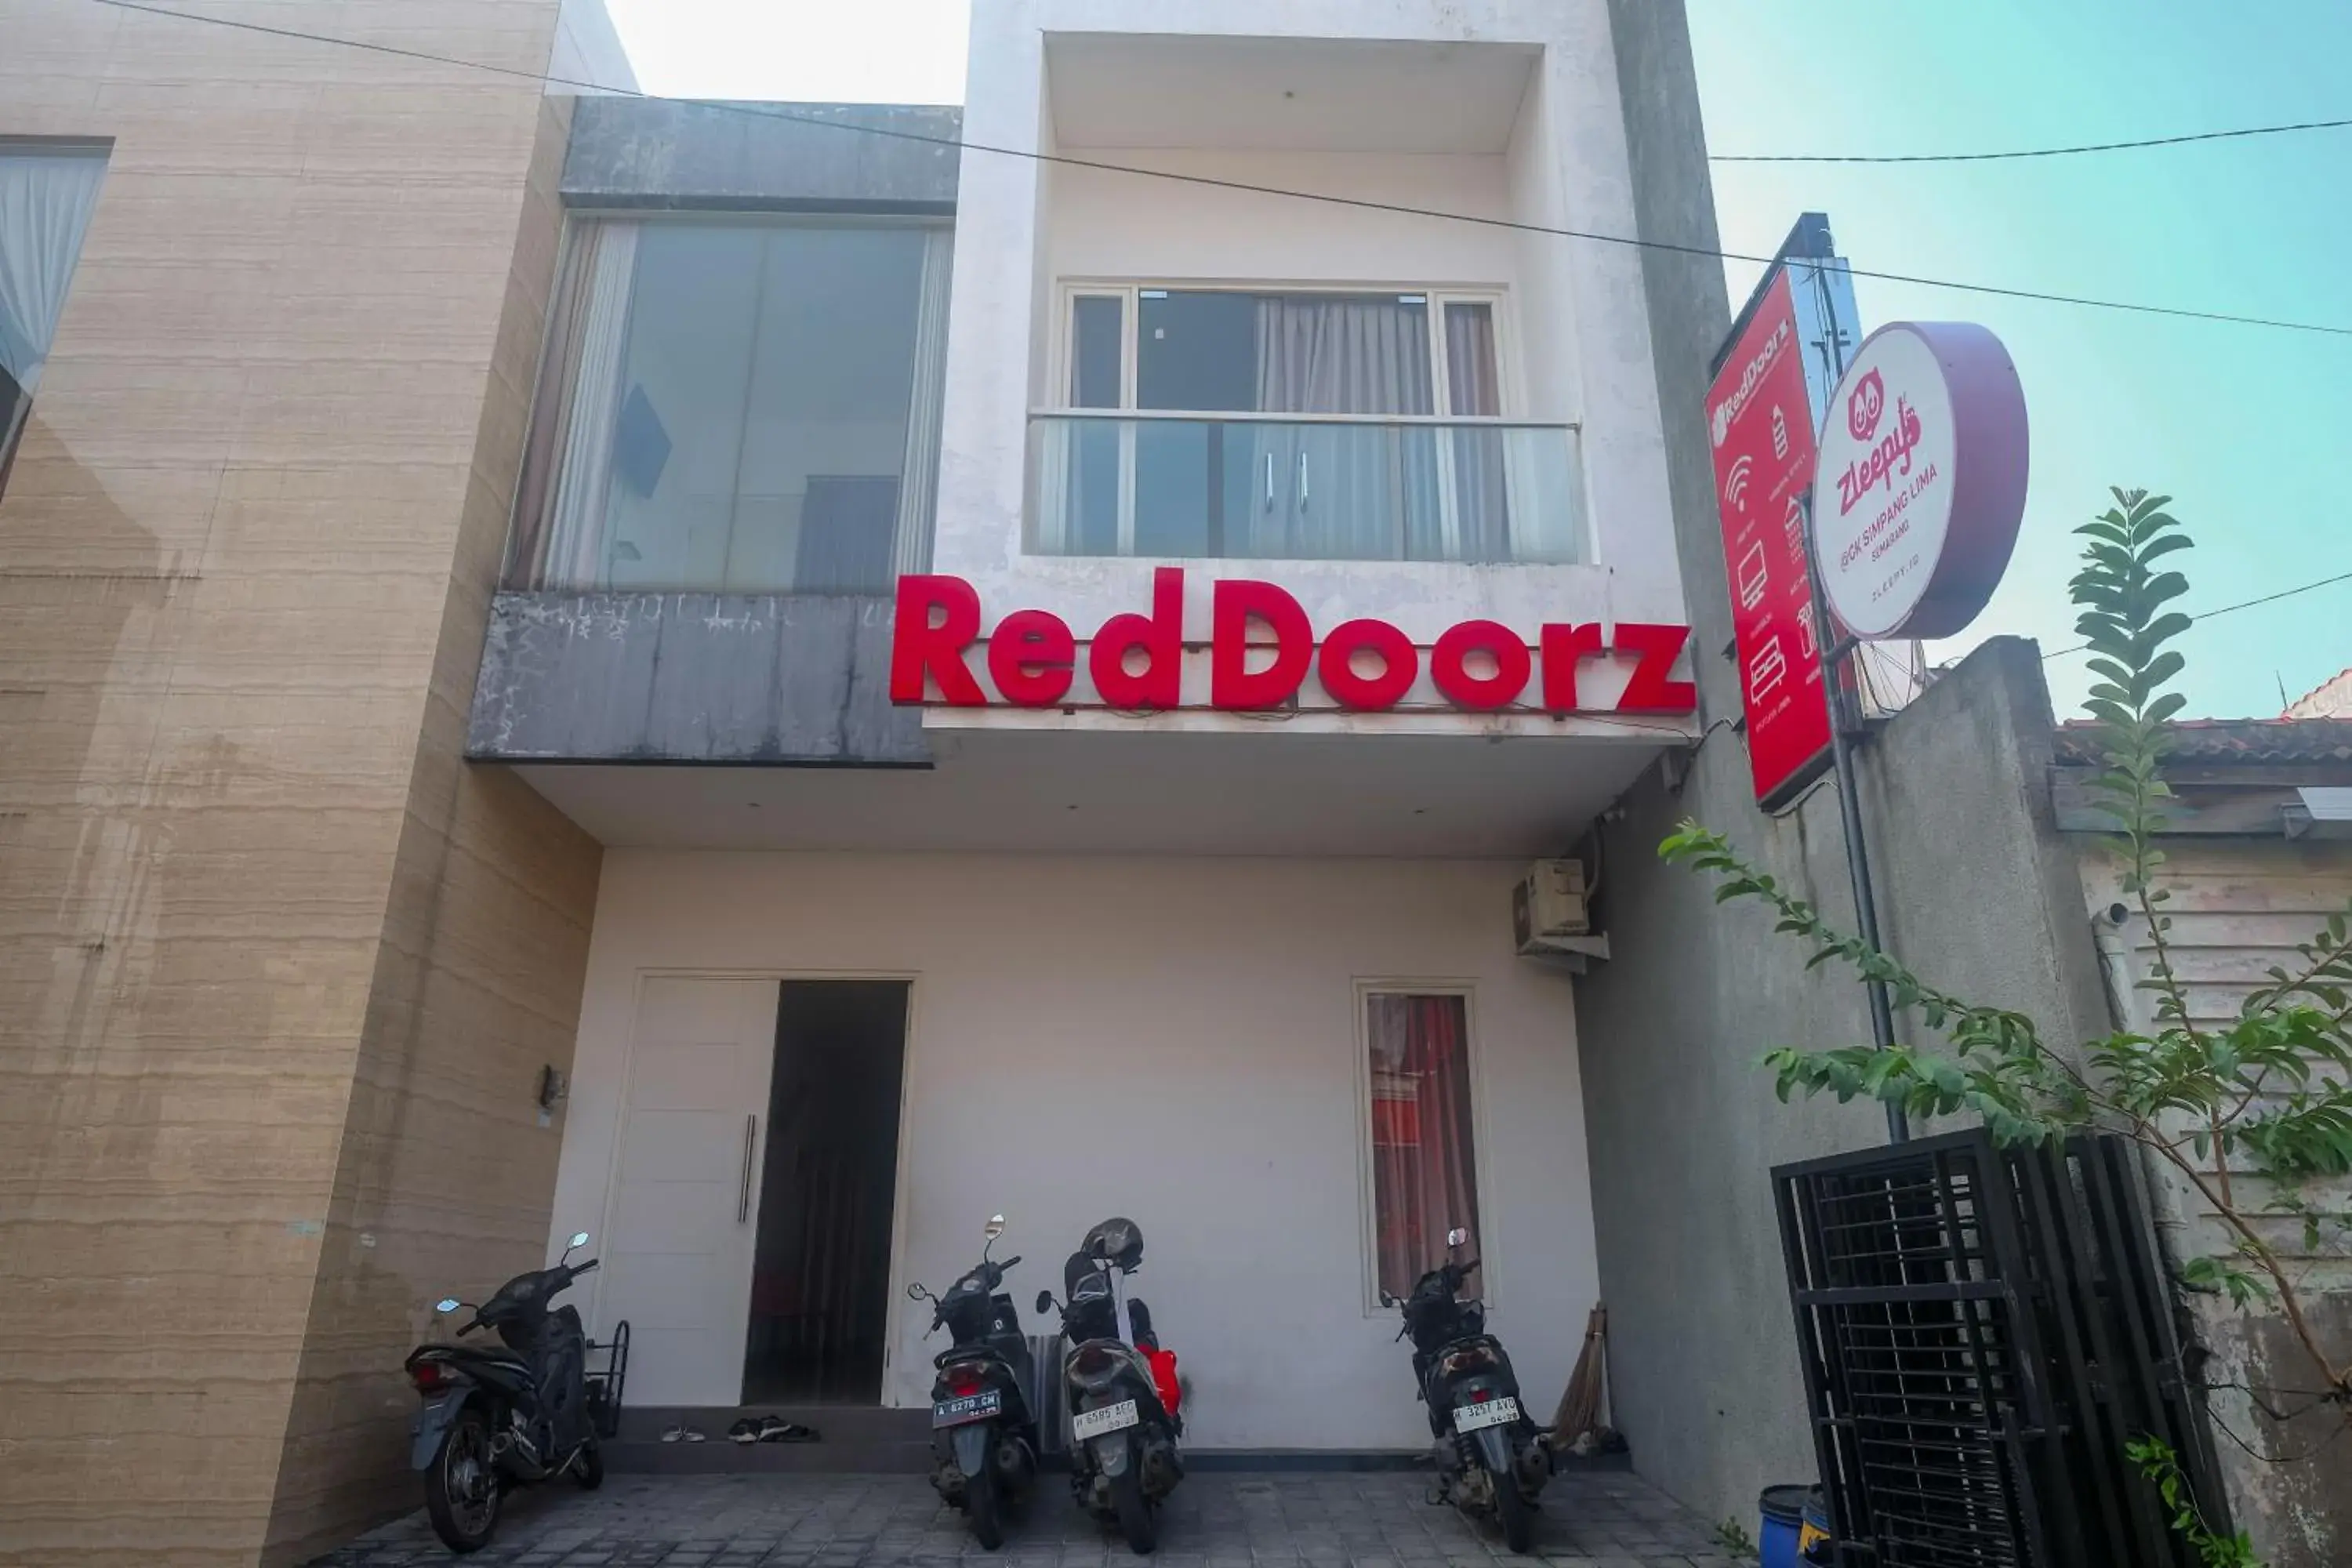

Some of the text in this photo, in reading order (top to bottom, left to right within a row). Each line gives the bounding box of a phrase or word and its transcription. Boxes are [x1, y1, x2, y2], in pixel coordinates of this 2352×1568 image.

[1862, 491, 1908, 546] SIMPANG
[1909, 463, 1937, 499] LIMA
[889, 567, 1697, 715] RedDoorz
